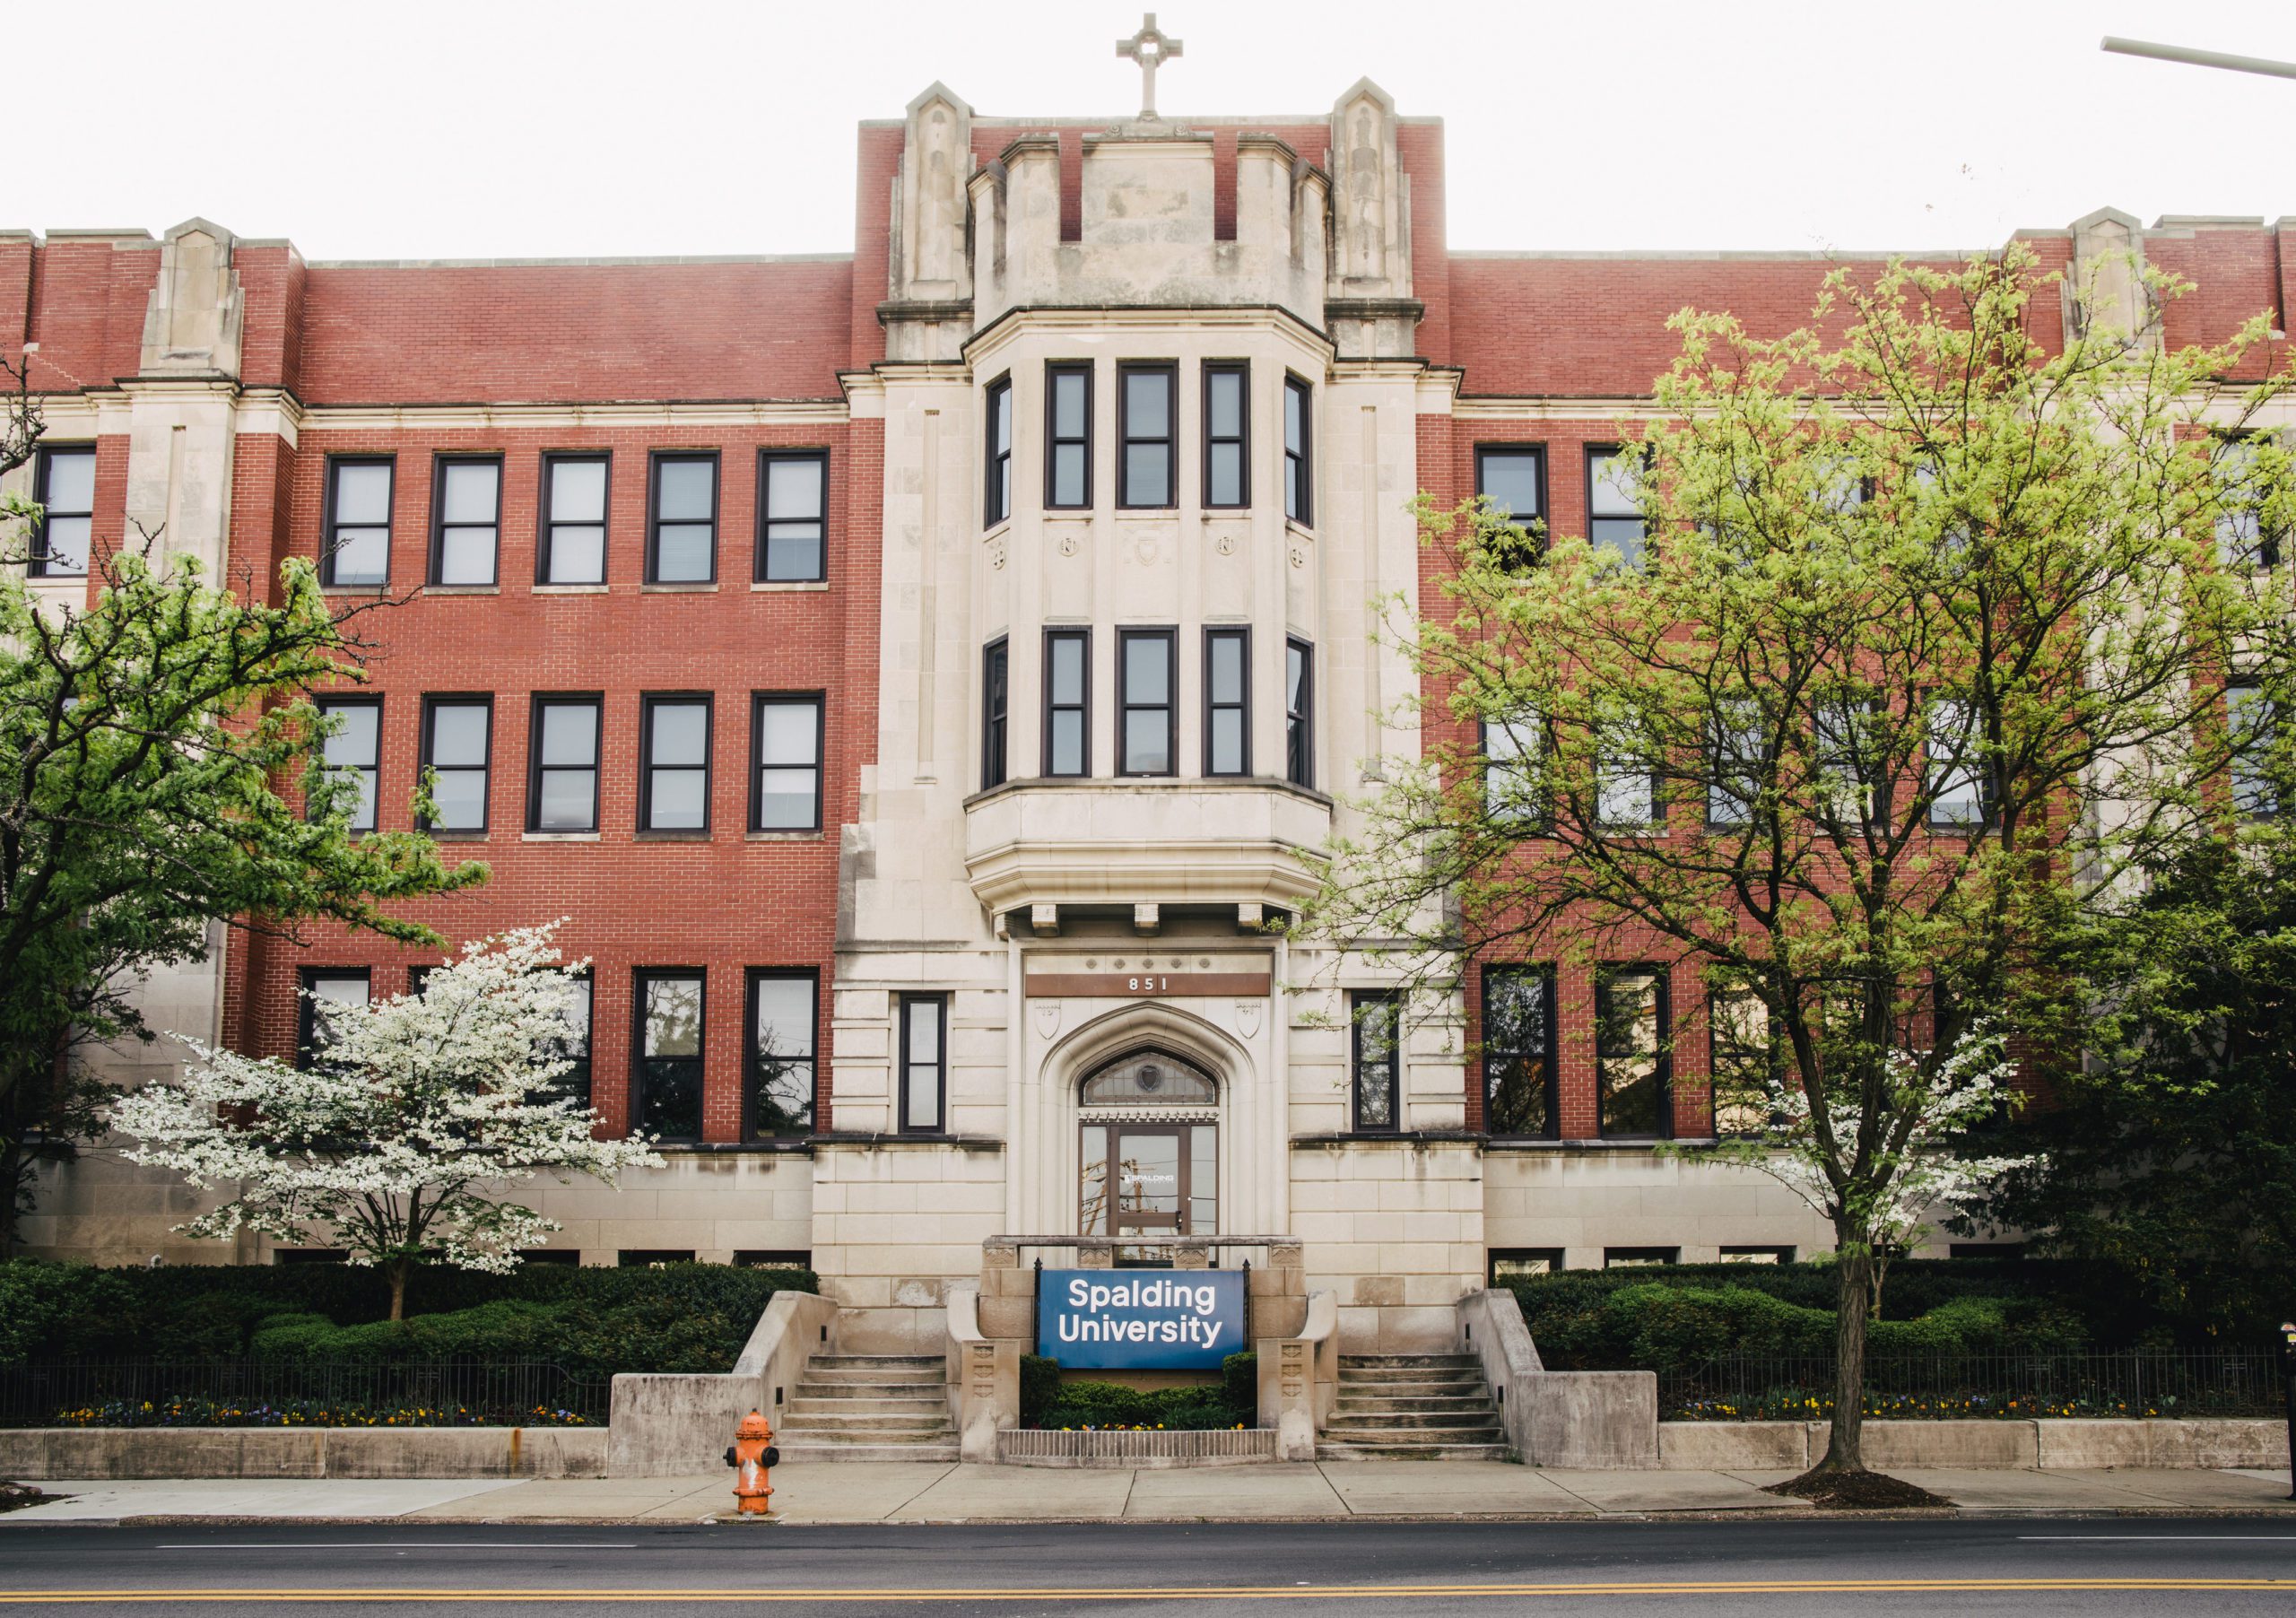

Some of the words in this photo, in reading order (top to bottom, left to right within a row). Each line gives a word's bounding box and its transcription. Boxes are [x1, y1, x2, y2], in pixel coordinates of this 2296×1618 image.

[1128, 978, 1167, 990] 851
[1068, 1279, 1215, 1316] Spalding
[1058, 1314, 1223, 1349] University
